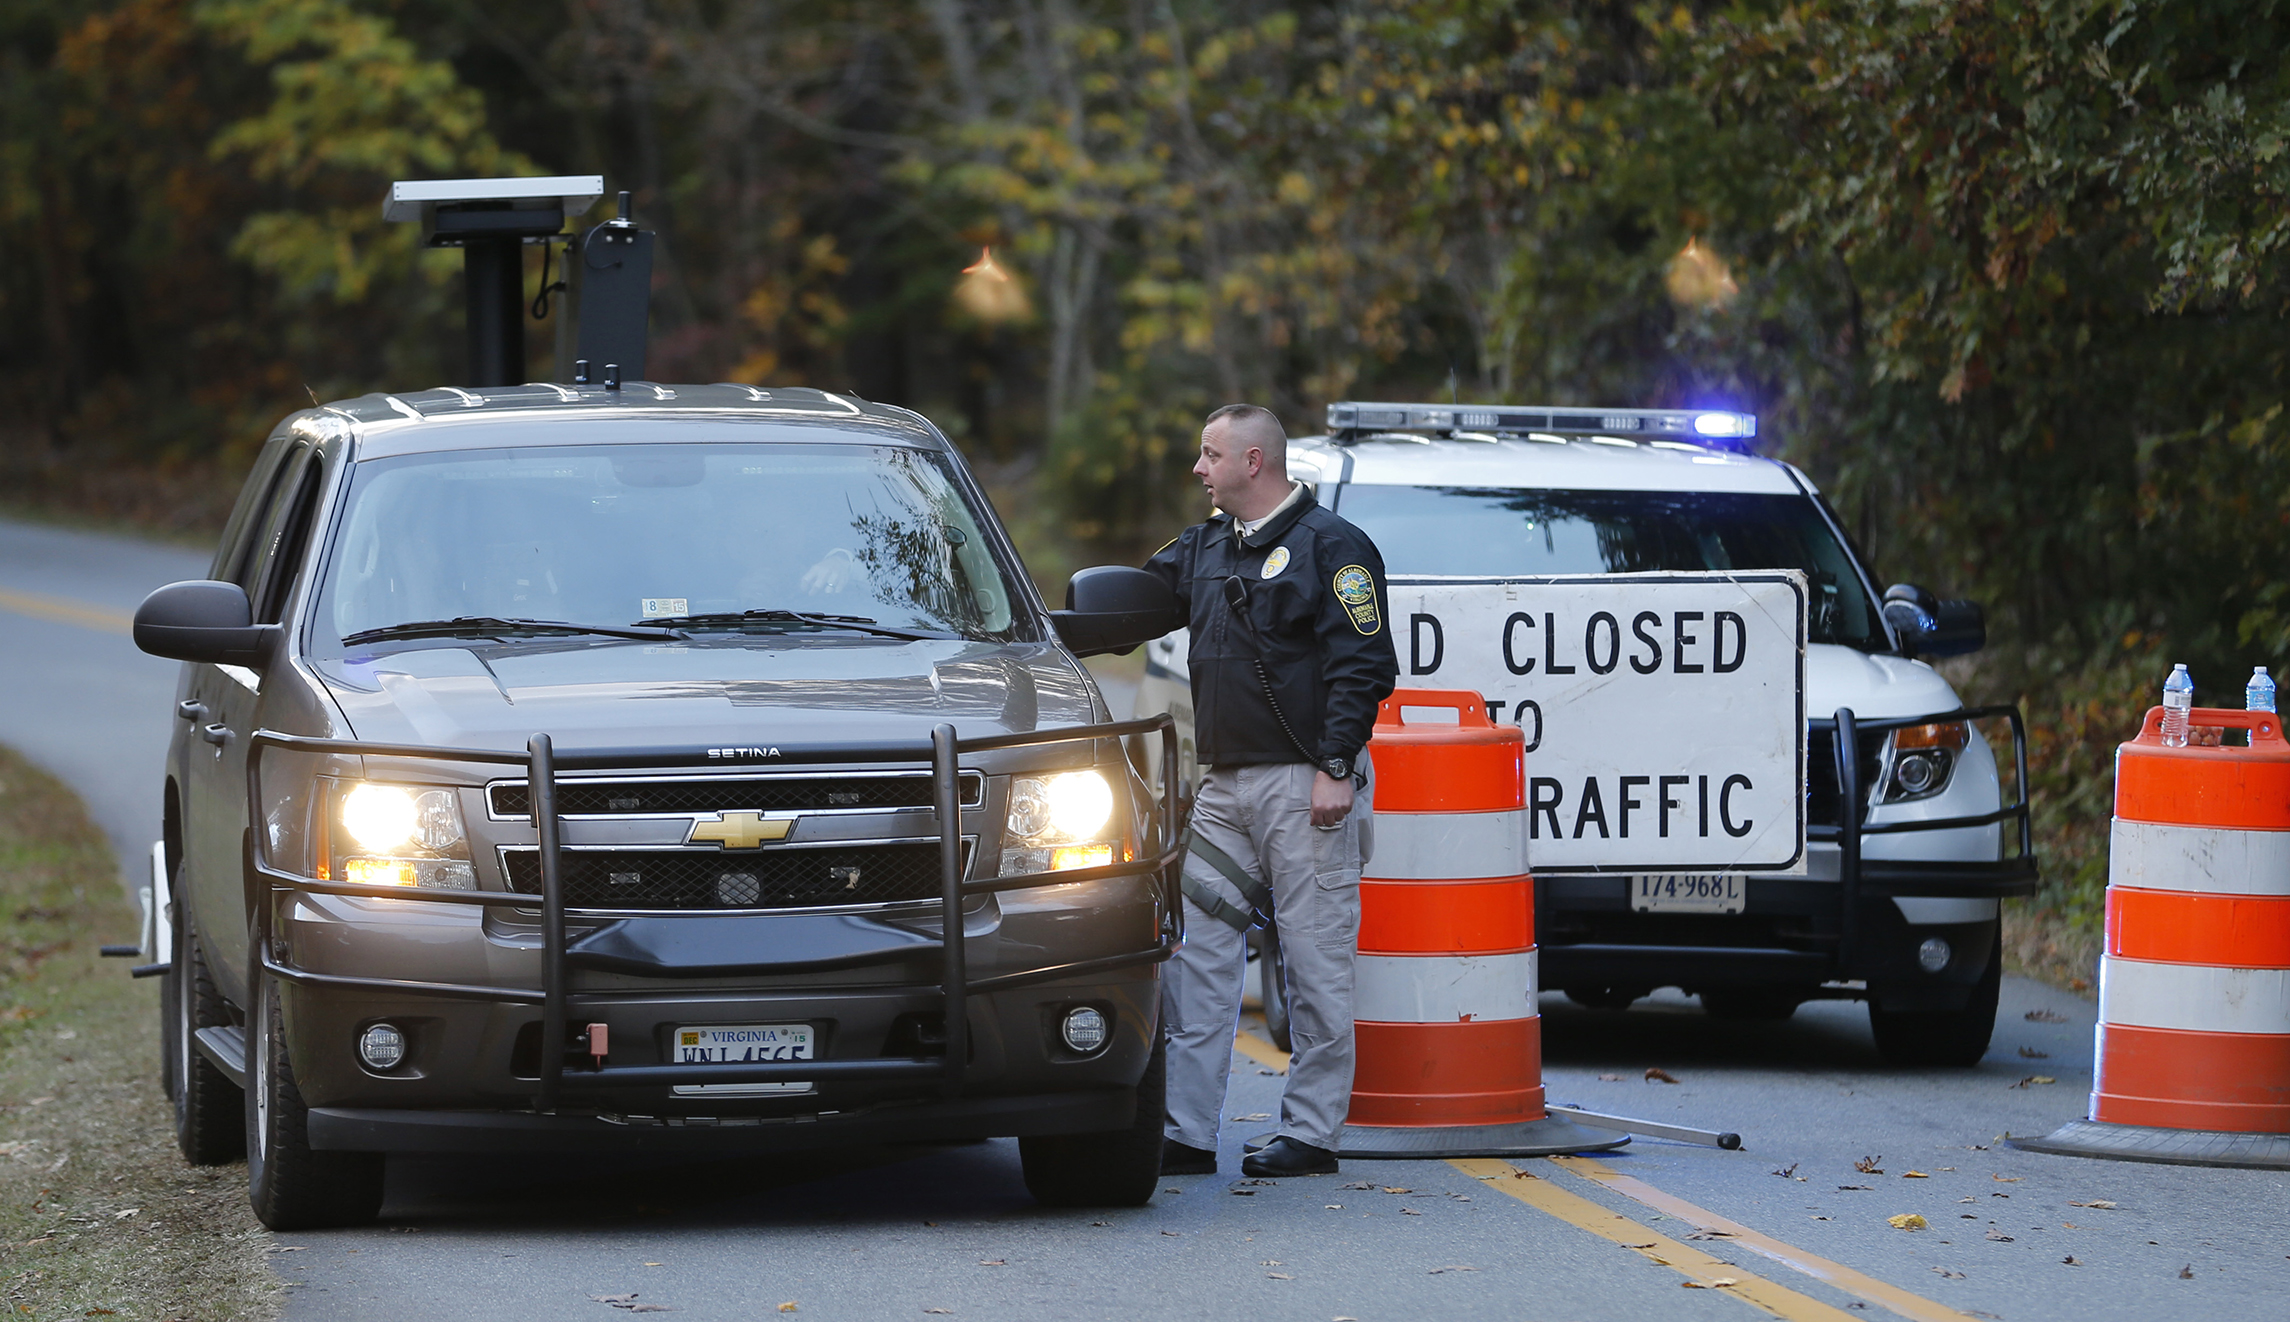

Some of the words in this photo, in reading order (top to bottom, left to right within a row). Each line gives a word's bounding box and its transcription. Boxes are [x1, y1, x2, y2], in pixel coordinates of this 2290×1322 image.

[649, 600, 657, 611] 8
[673, 602, 685, 612] 15
[1358, 615, 1376, 625] POLICE
[1502, 611, 1747, 675] CLOSED
[707, 747, 782, 759] SETINA
[1529, 774, 1753, 840] RAFFIC
[683, 1036, 698, 1045] DEC
[711, 1030, 778, 1043] VIRGINIA
[794, 1034, 806, 1043] 15
